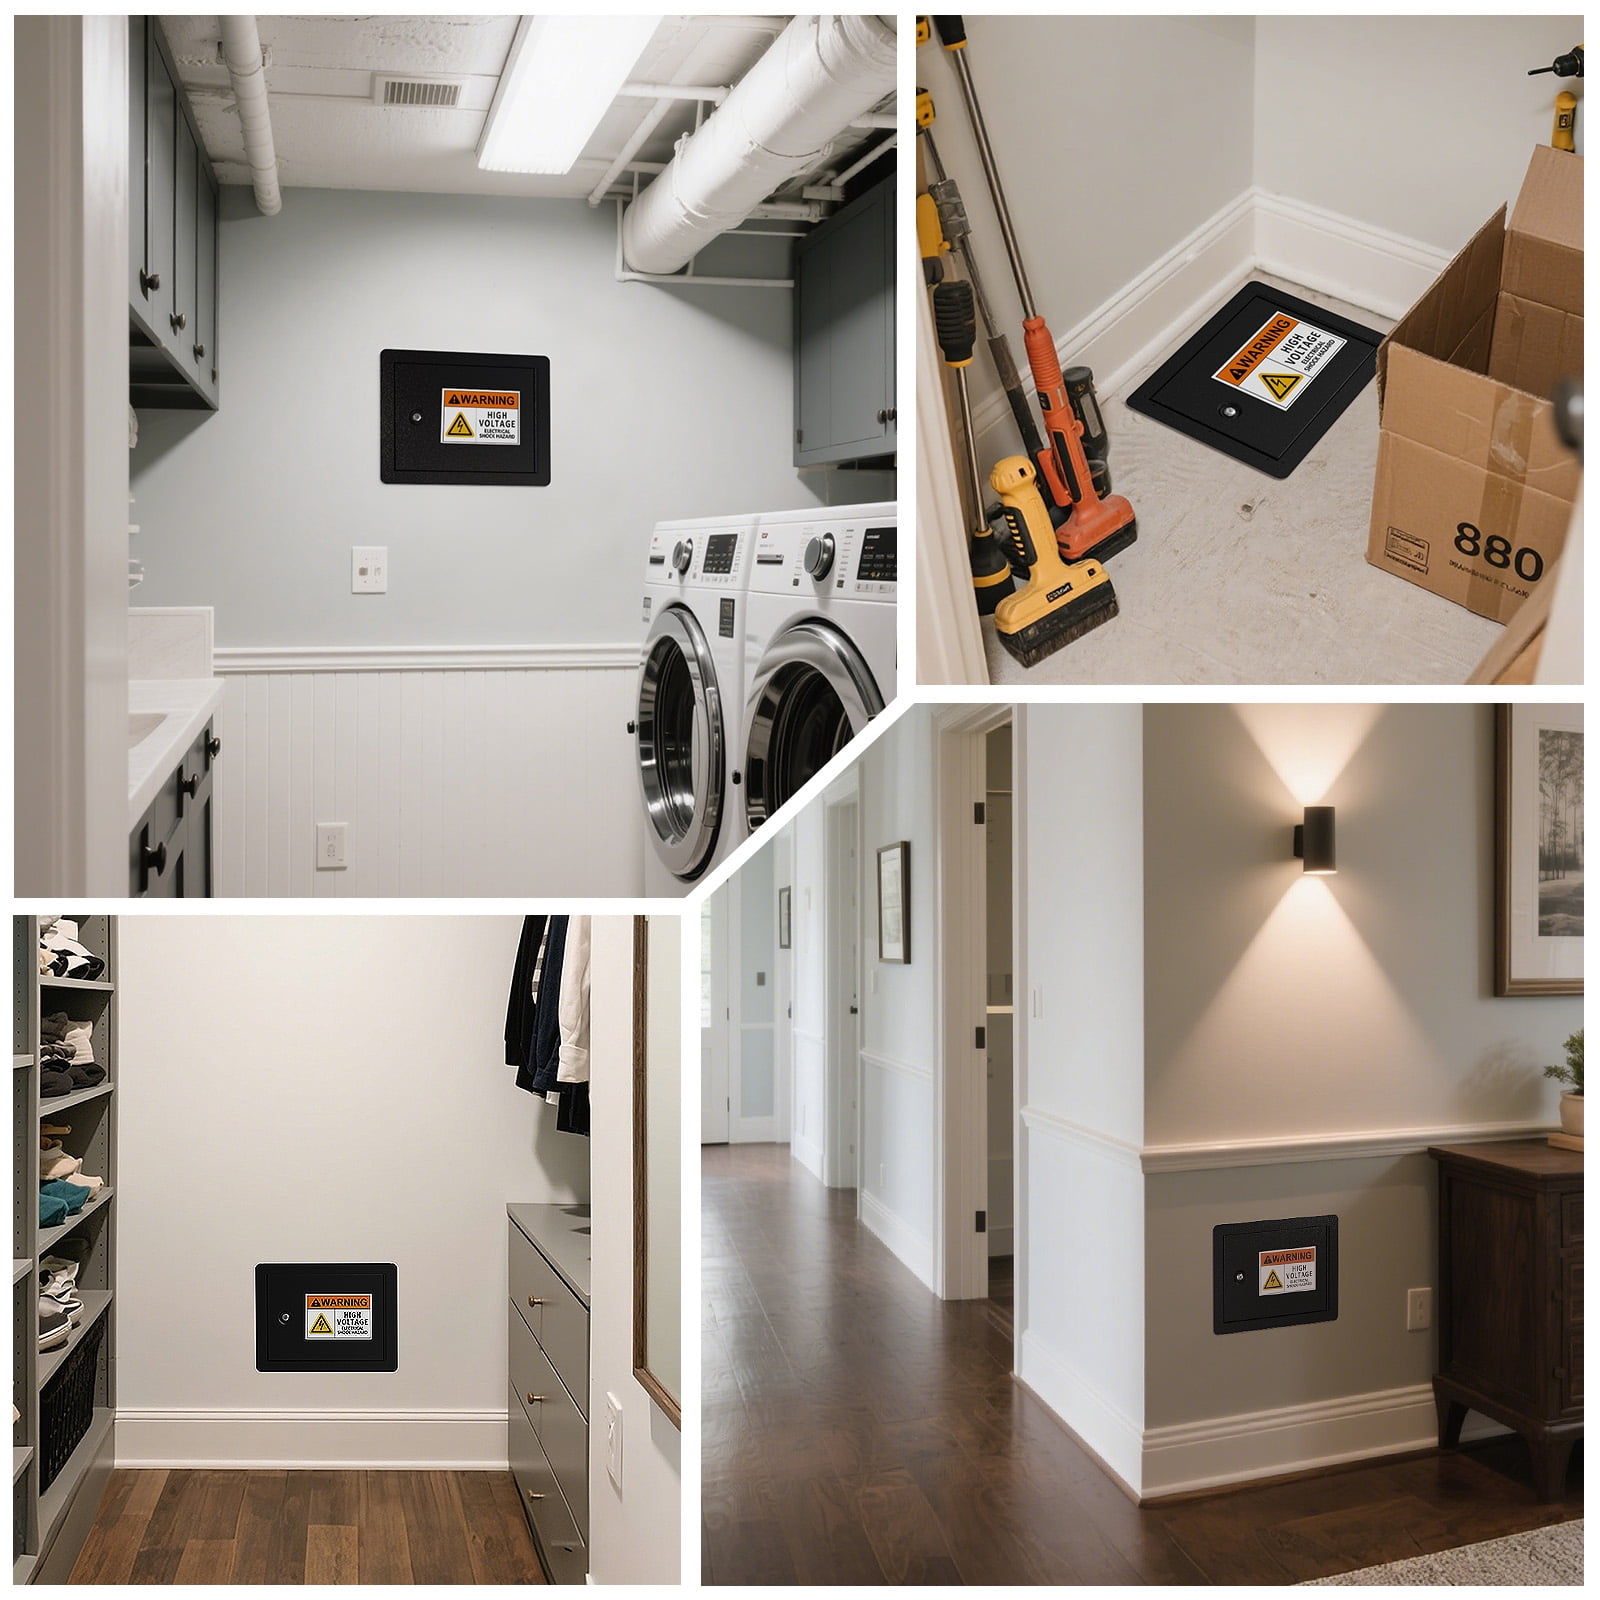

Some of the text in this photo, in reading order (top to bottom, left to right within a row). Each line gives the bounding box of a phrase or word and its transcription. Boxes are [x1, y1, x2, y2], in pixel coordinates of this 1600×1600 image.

[1240, 319, 1291, 369] WARNING
[1280, 333, 1304, 354] HIGH
[1285, 331, 1321, 365] VOLTAGE
[1301, 341, 1326, 365] ELECTRICAL
[1304, 339, 1336, 372] SHOCK HAZARD
[460, 394, 515, 406] WARNING
[487, 411, 508, 419] HIGH
[479, 419, 516, 428] VOLTAGE
[1454, 522, 1544, 582] 880
[1272, 1252, 1312, 1262] WARNING
[1286, 1271, 1312, 1279] VOLTAGE
[320, 1298, 368, 1306] WARNING
[336, 1318, 369, 1326] VOLTAGE
